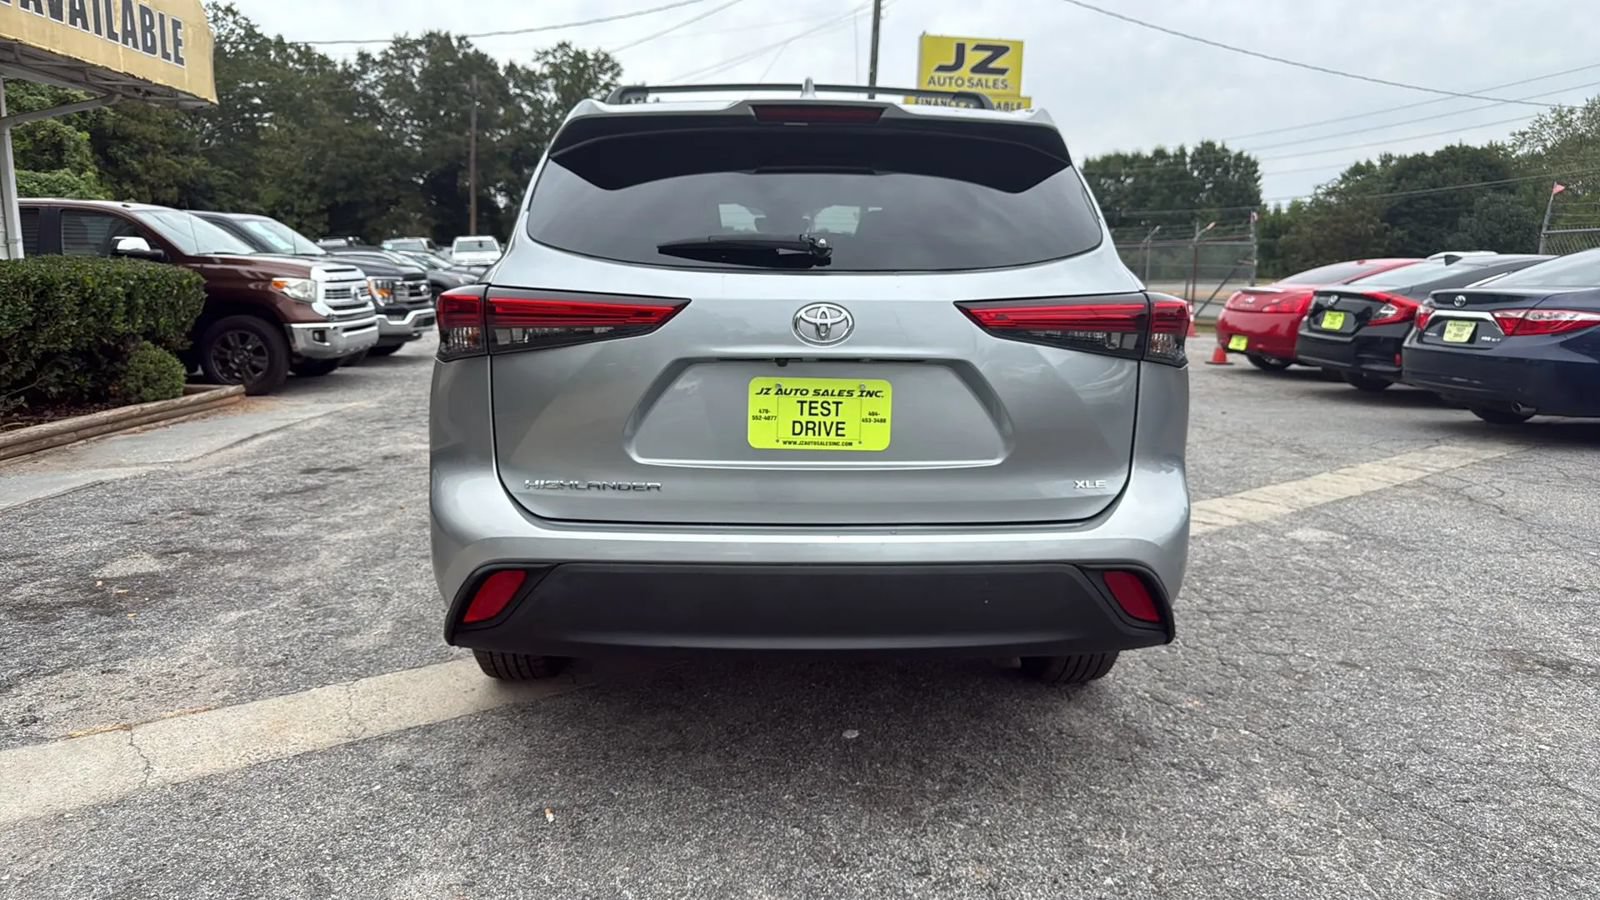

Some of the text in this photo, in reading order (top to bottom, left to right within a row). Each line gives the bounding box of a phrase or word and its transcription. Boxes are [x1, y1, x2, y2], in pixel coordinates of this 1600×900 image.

[934, 42, 1010, 75] JZ
[927, 75, 1008, 89] AUTO SALES
[755, 387, 772, 396] JZ
[774, 386, 809, 397] AUTO
[812, 389, 855, 398] SALES
[796, 400, 843, 417] TEST
[791, 420, 846, 437] DRIVE
[524, 479, 662, 492] HIGHLANDER
[1073, 479, 1107, 489] XLE
